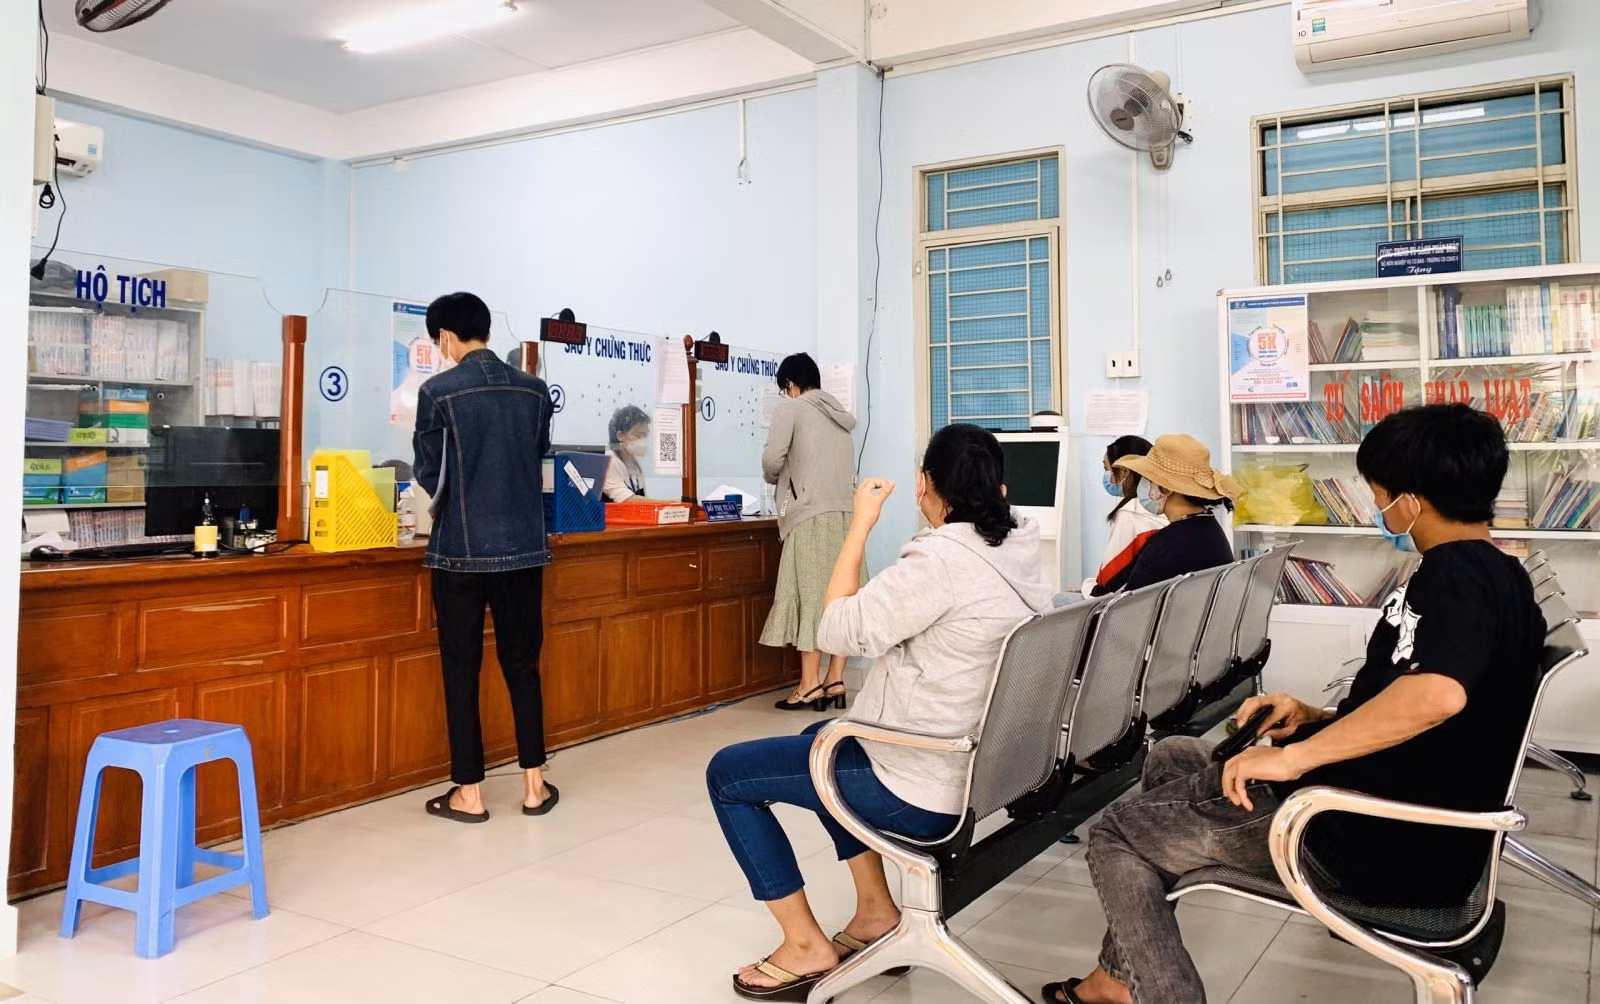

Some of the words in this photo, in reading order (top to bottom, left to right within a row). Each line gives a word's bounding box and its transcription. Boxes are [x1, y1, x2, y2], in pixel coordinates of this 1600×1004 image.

[76, 265, 108, 314] HỘ
[117, 275, 166, 313] TỊCH
[585, 337, 592, 356] Y
[628, 340, 651, 366] THỰC
[1258, 336, 1277, 349] 5K
[416, 346, 432, 365] 5K
[730, 356, 735, 372] Y
[328, 372, 341, 396] 3
[551, 390, 561, 408] 2
[1361, 371, 1405, 422] SÁCH
[1484, 368, 1532, 426] LUẬT
[705, 401, 711, 417] 1
